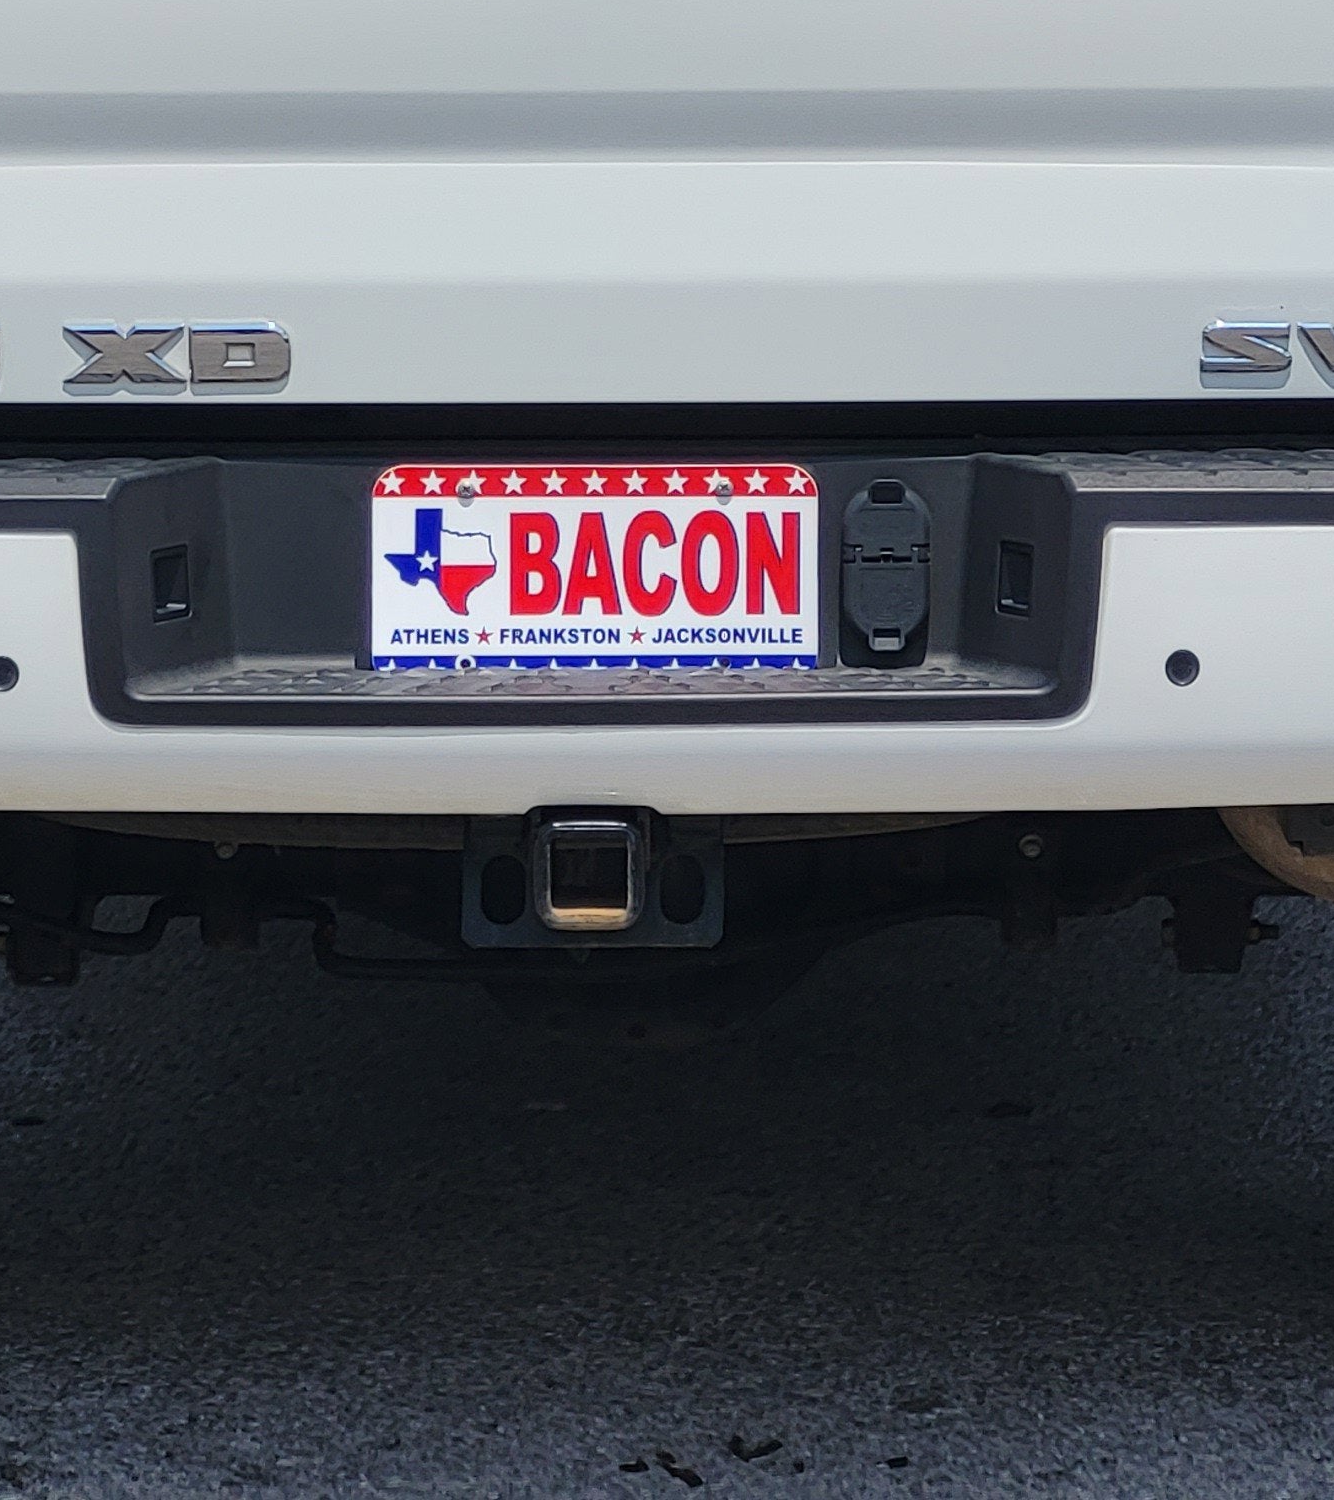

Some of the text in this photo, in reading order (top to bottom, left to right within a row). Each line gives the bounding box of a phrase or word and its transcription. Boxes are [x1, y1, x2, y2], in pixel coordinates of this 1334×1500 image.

[62, 319, 292, 386] XD
[508, 509, 801, 617] BACON
[389, 627, 803, 645] ATHENS FRANKSTON JACKSONVILLE
